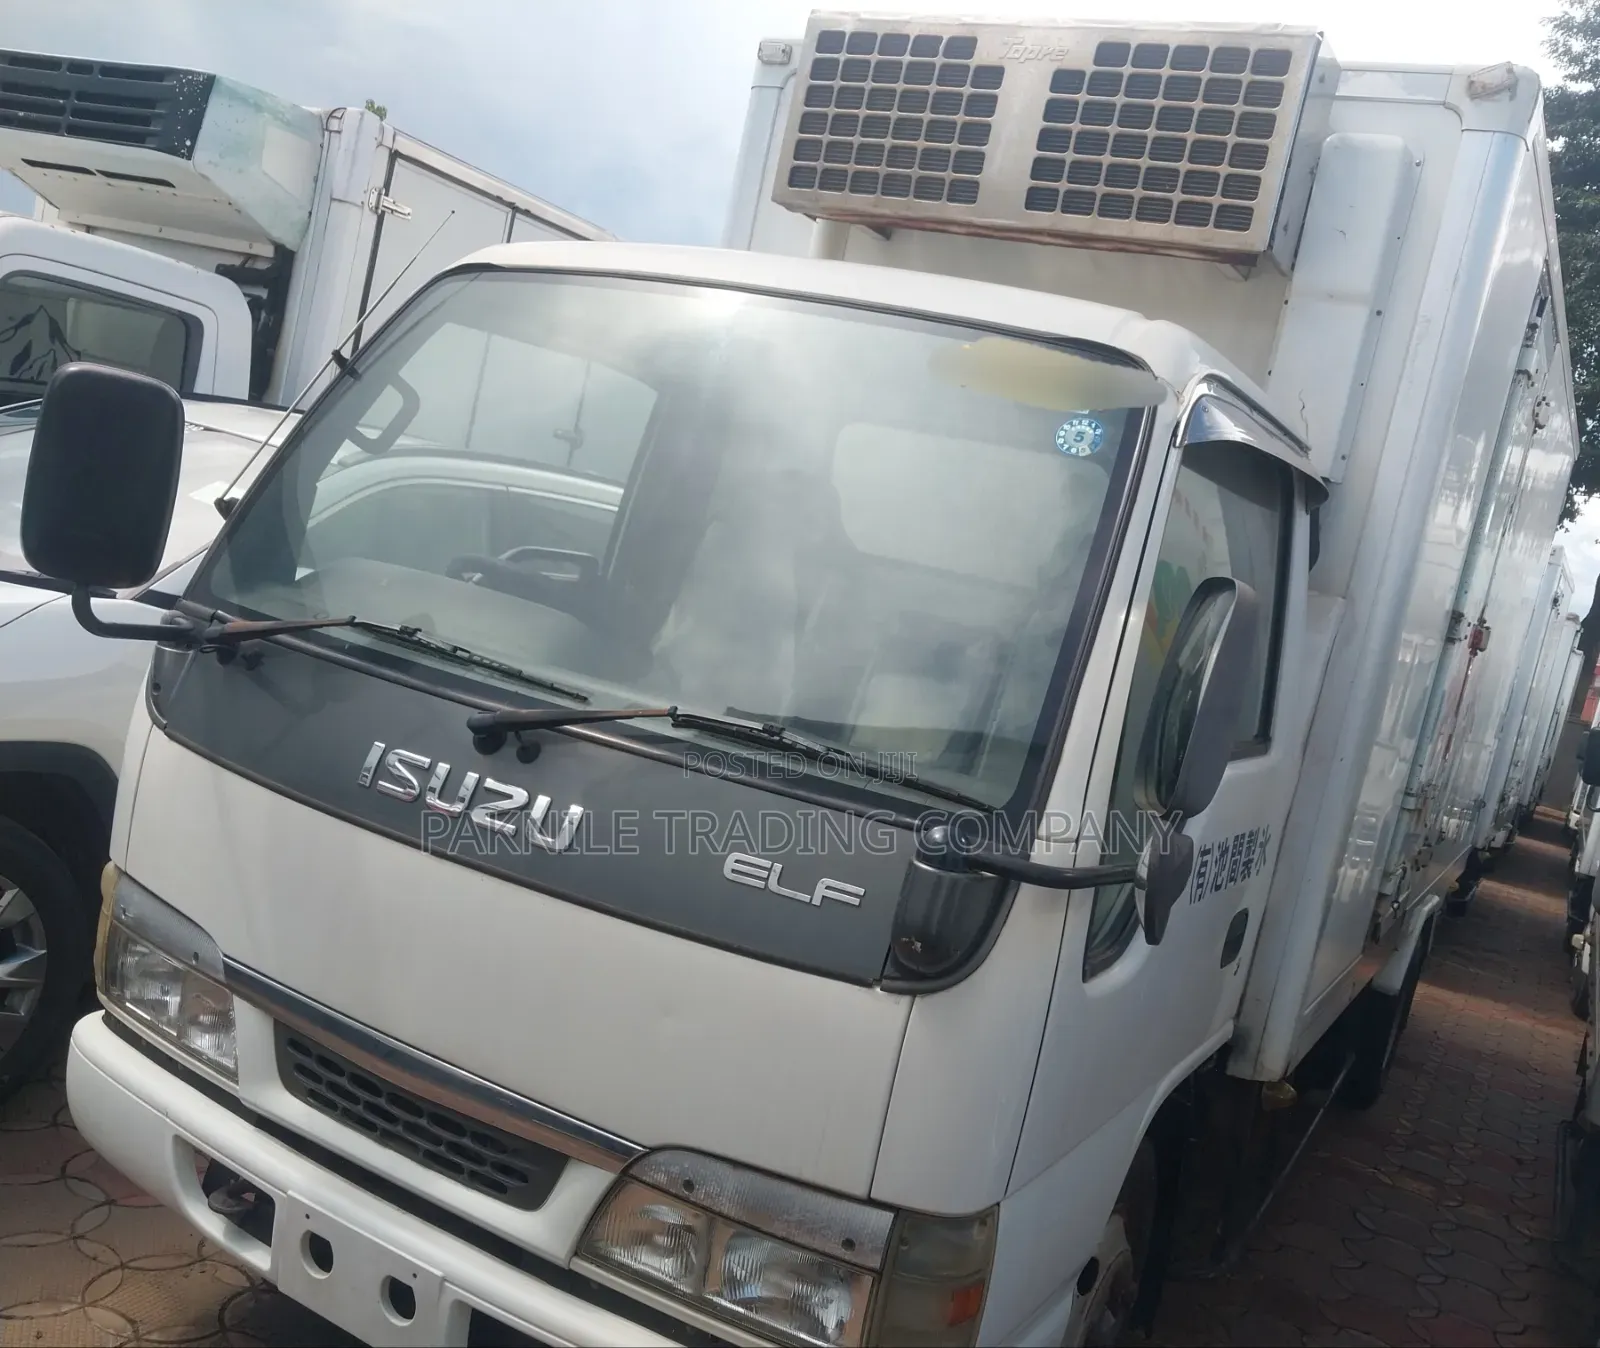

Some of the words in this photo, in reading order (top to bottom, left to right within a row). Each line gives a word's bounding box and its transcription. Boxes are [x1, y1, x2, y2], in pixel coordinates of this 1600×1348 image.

[1000, 36, 1069, 63] Topre
[1073, 431, 1086, 443] 5
[357, 741, 584, 852] ISUZU
[723, 852, 865, 906] ELF
